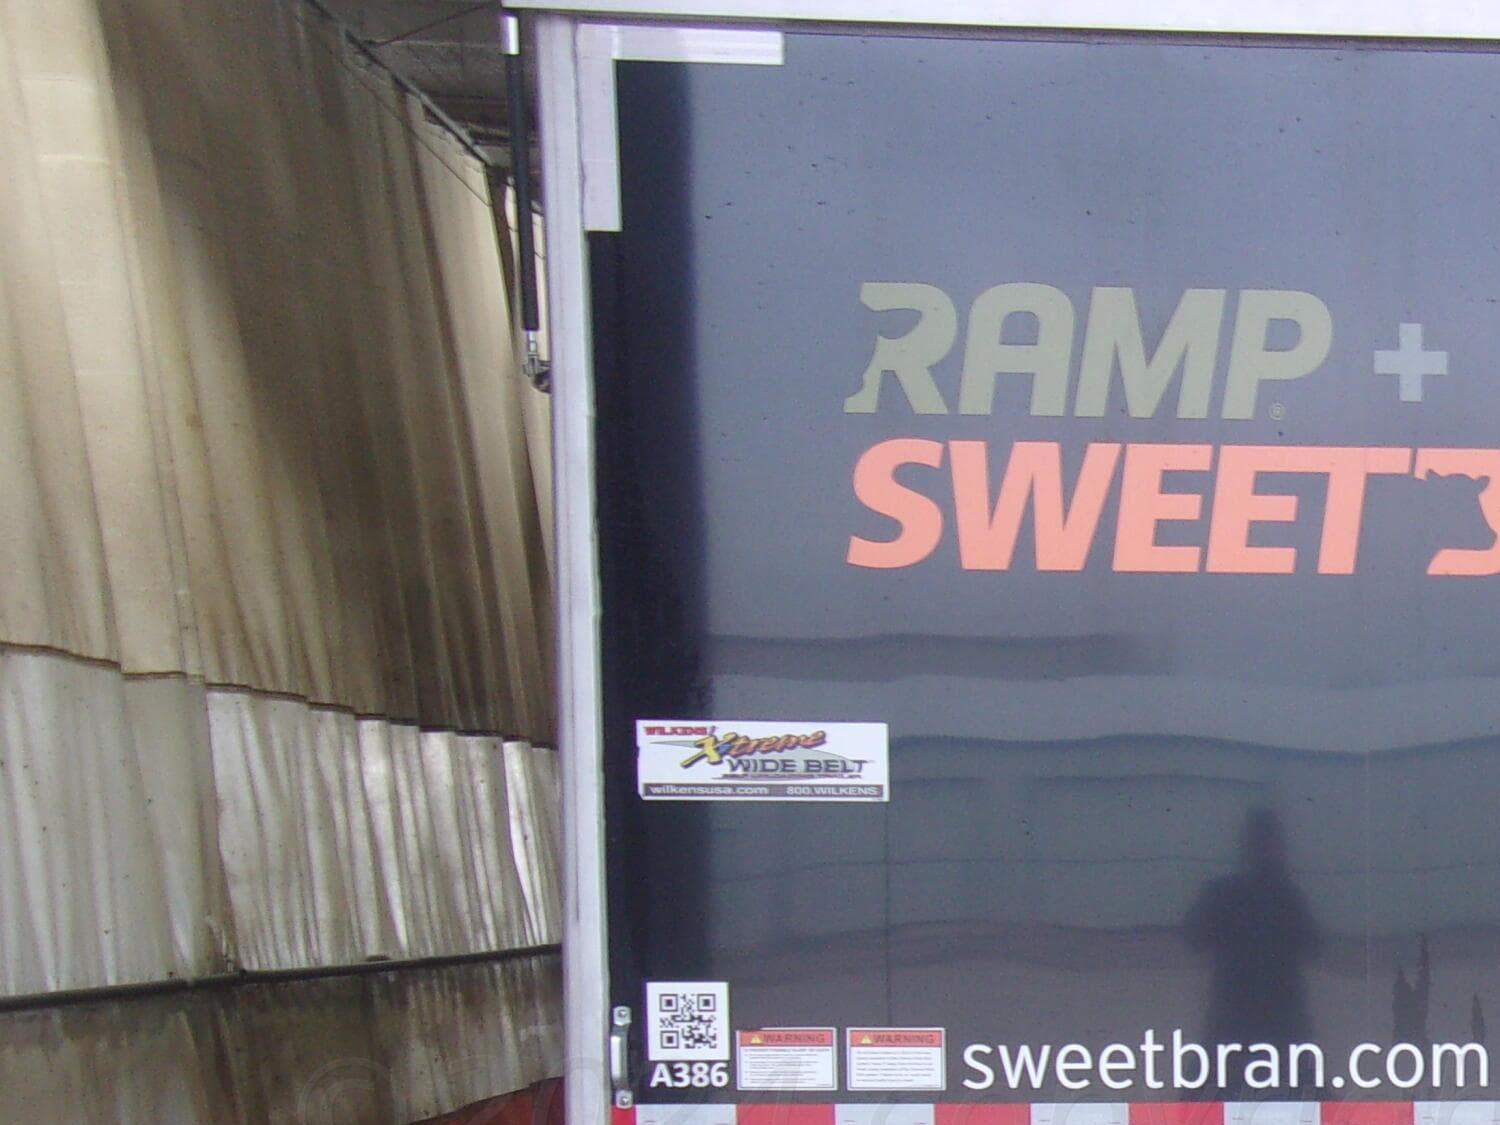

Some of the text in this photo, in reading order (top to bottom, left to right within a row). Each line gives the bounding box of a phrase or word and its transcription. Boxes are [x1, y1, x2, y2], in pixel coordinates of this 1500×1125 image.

[727, 759, 868, 773] WIDE BELT
[649, 784, 878, 797] wilkensusa.com 800.WILKENS
[763, 1033, 826, 1045] WARNING
[873, 1033, 935, 1045] WARNING
[961, 1028, 1489, 1090] sweetbran.com
[649, 1061, 730, 1089] A386
